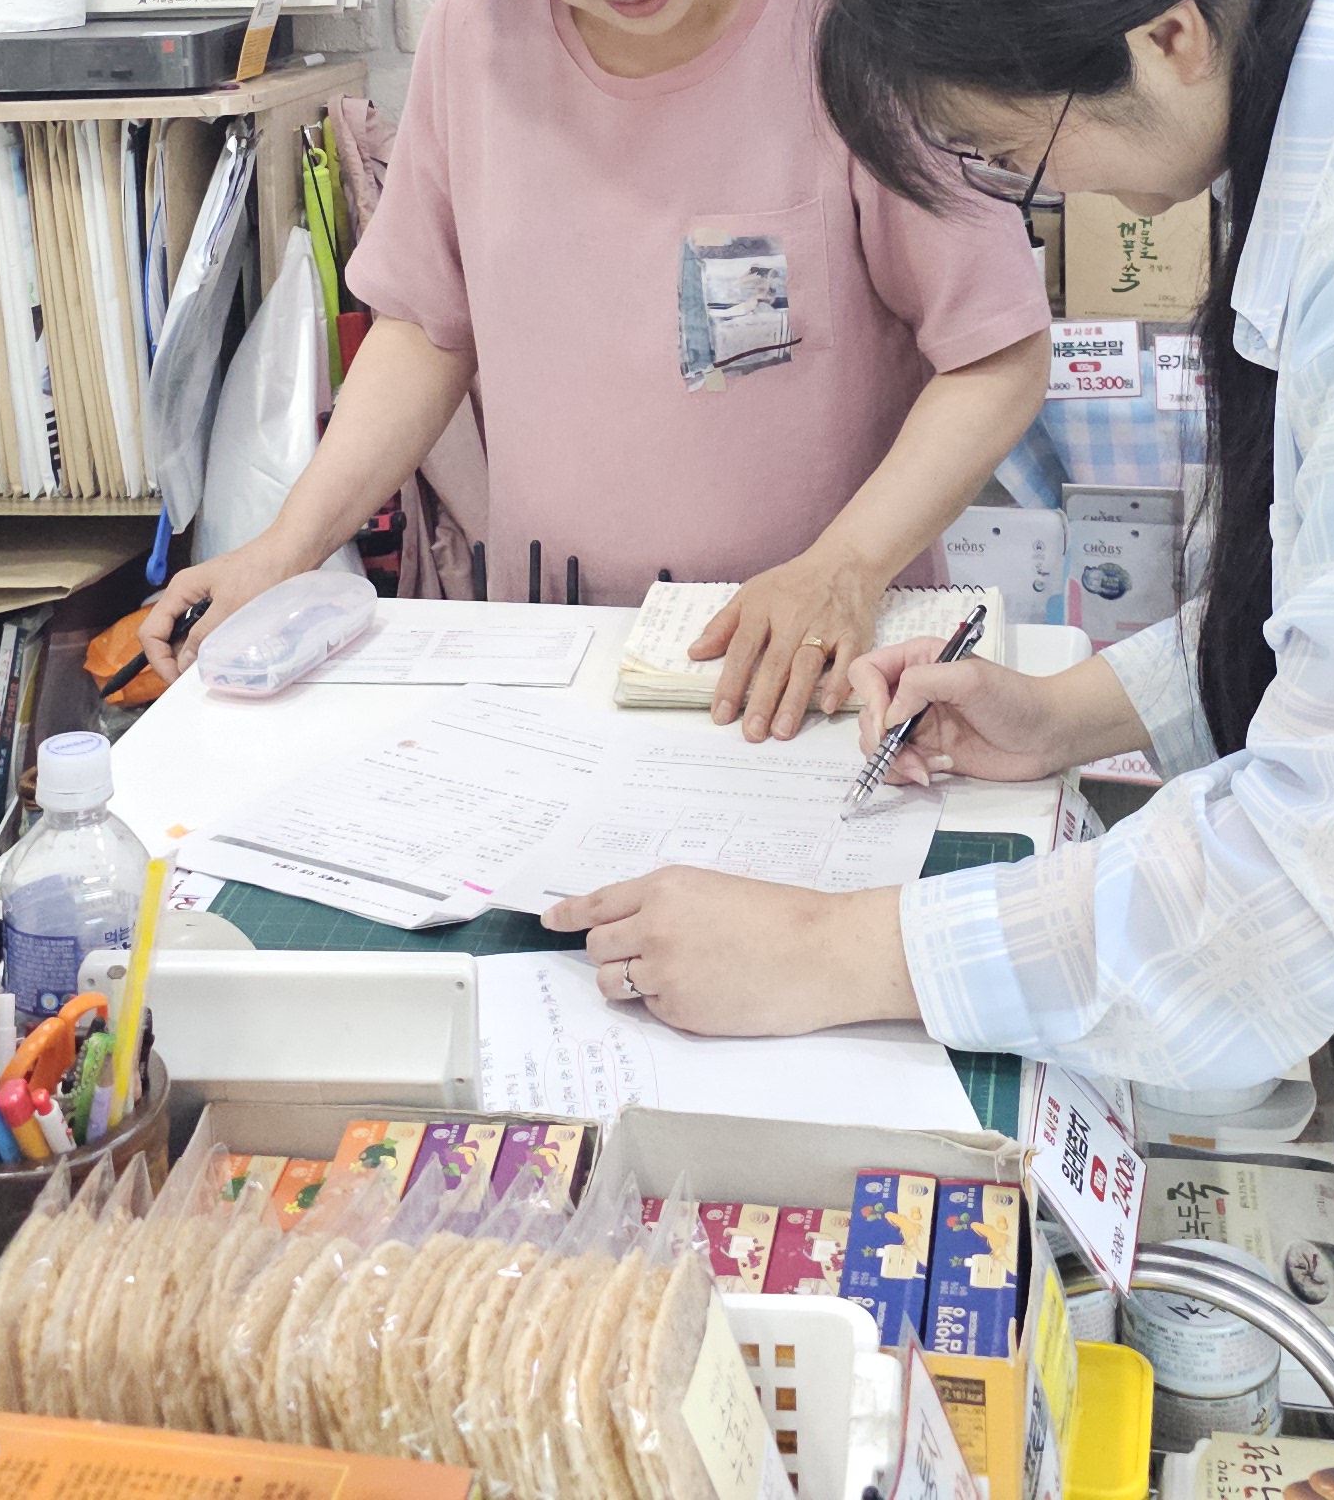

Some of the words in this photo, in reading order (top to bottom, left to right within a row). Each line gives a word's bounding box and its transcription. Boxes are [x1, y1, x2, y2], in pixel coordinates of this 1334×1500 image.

[1076, 375, 1134, 392] 13,300원
[947, 537, 987, 553] CHOBS
[1082, 540, 1123, 555] CHOBS
